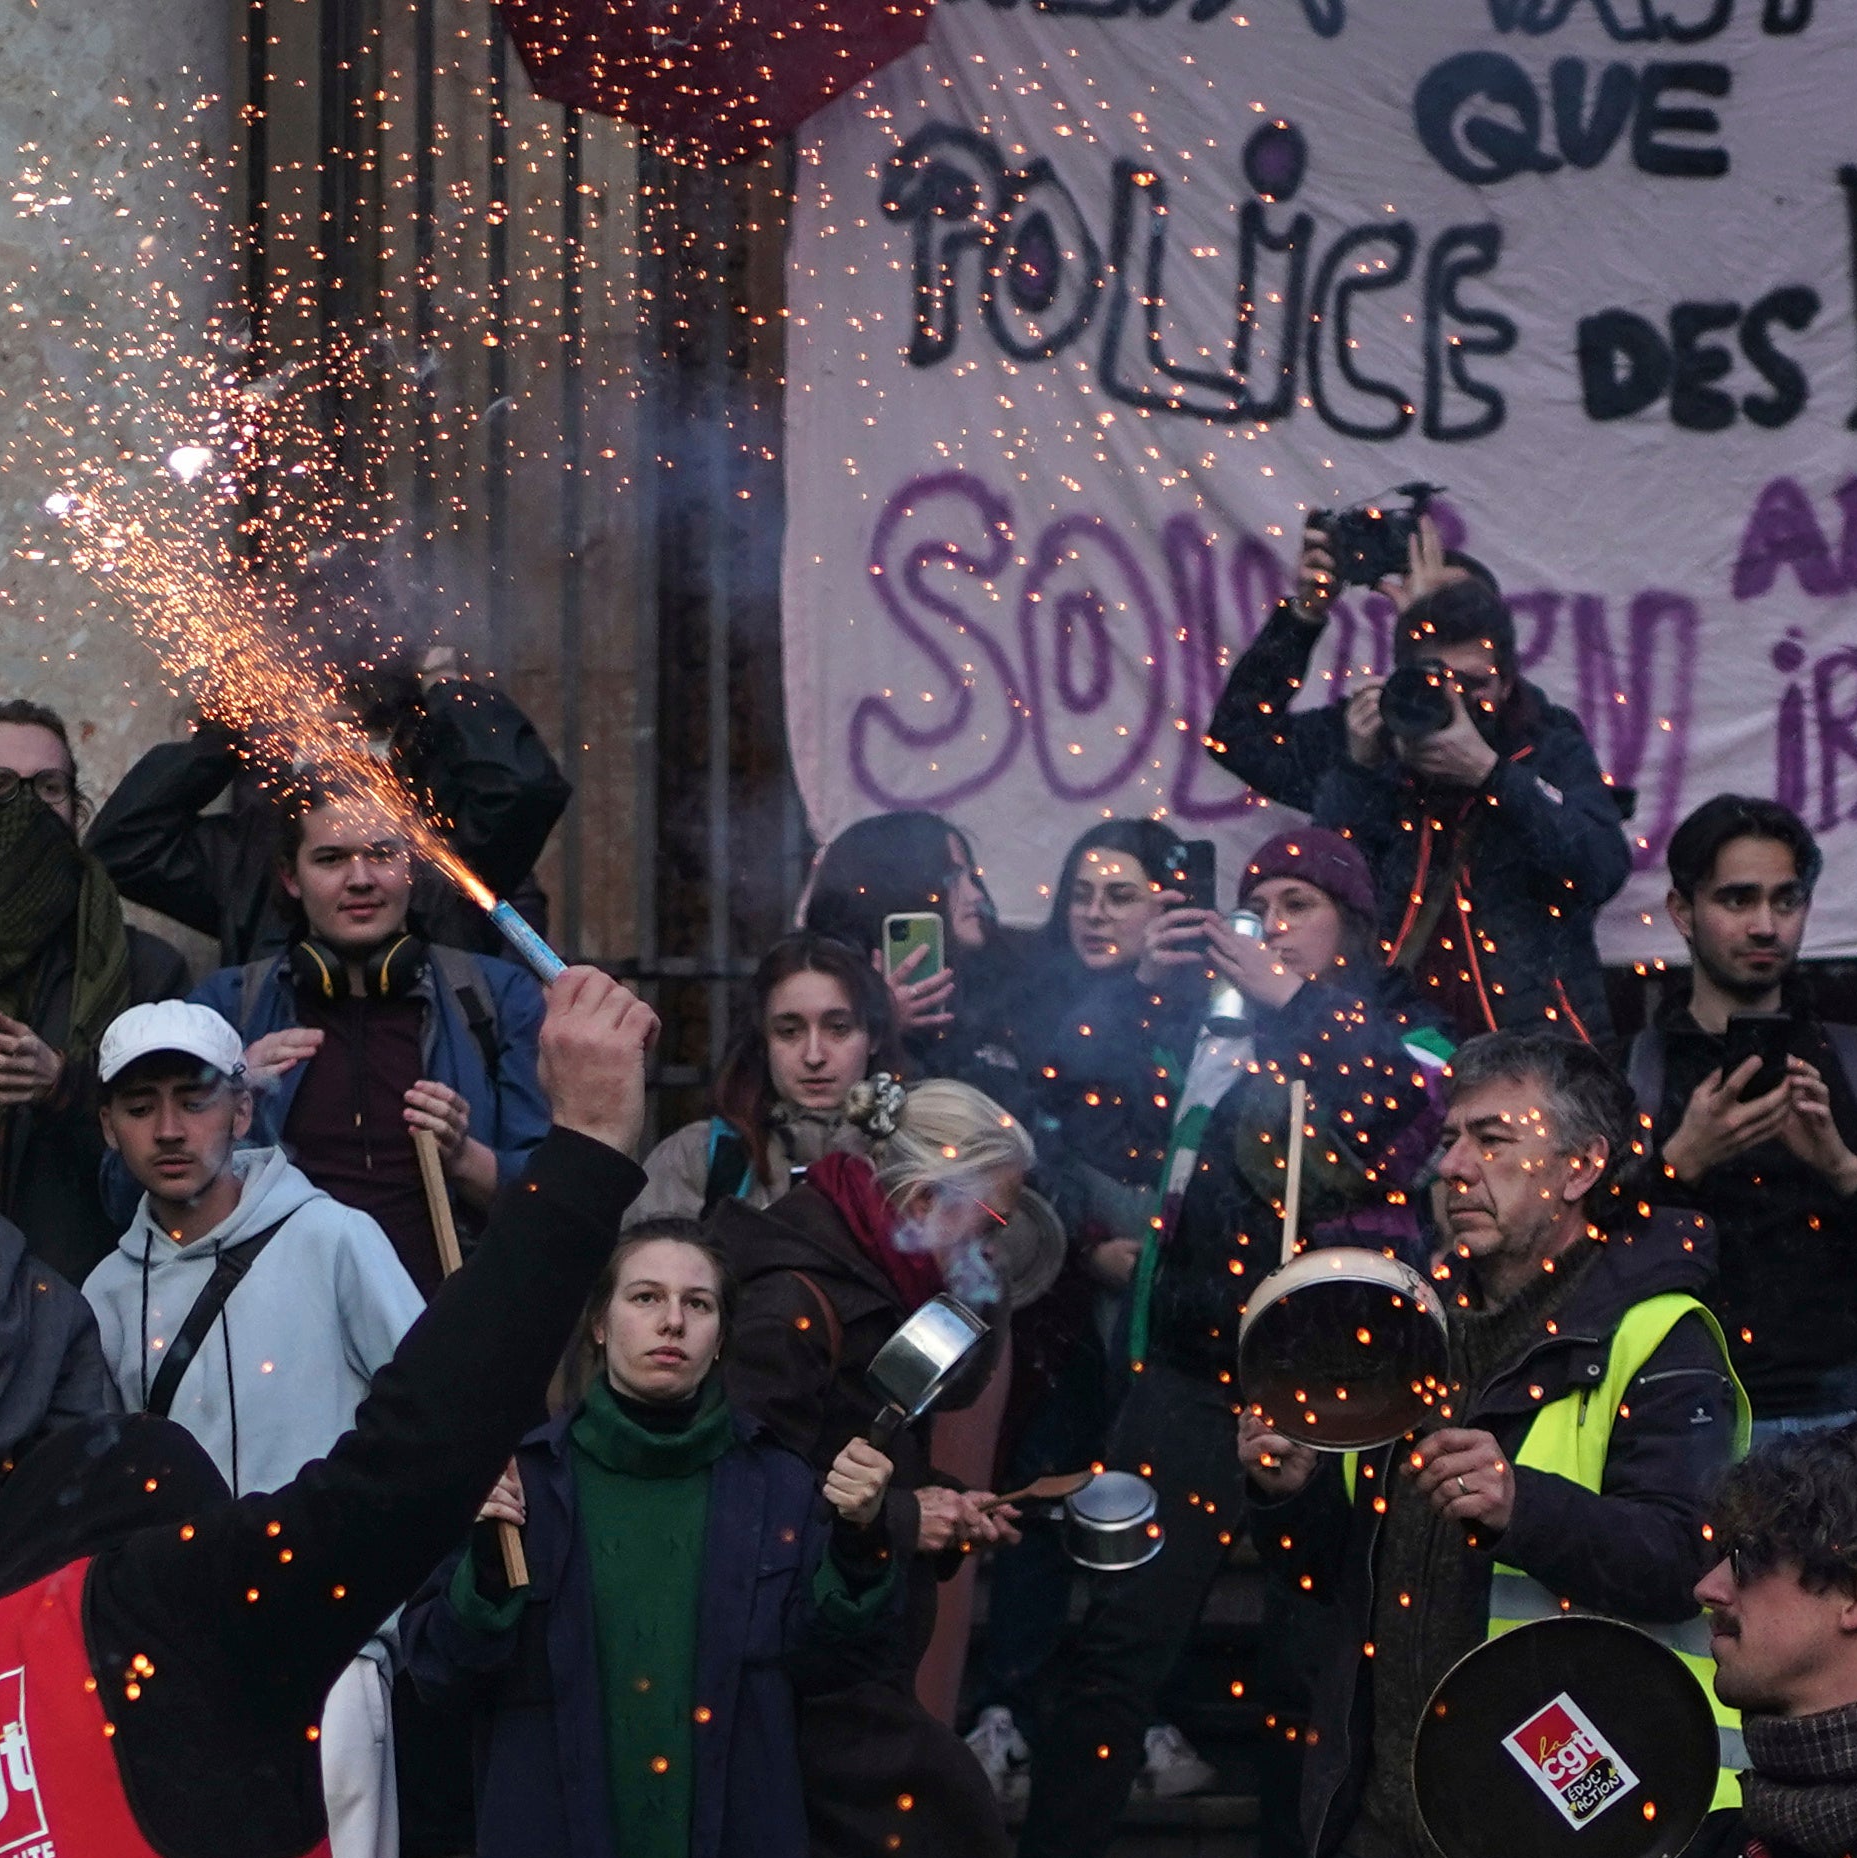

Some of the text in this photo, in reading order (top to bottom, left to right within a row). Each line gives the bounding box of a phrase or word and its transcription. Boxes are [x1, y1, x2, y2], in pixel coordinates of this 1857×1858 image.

[1414, 53, 1731, 186] QUE
[1576, 285, 1821, 430] DES
[1542, 1730, 1598, 1781] cgt
